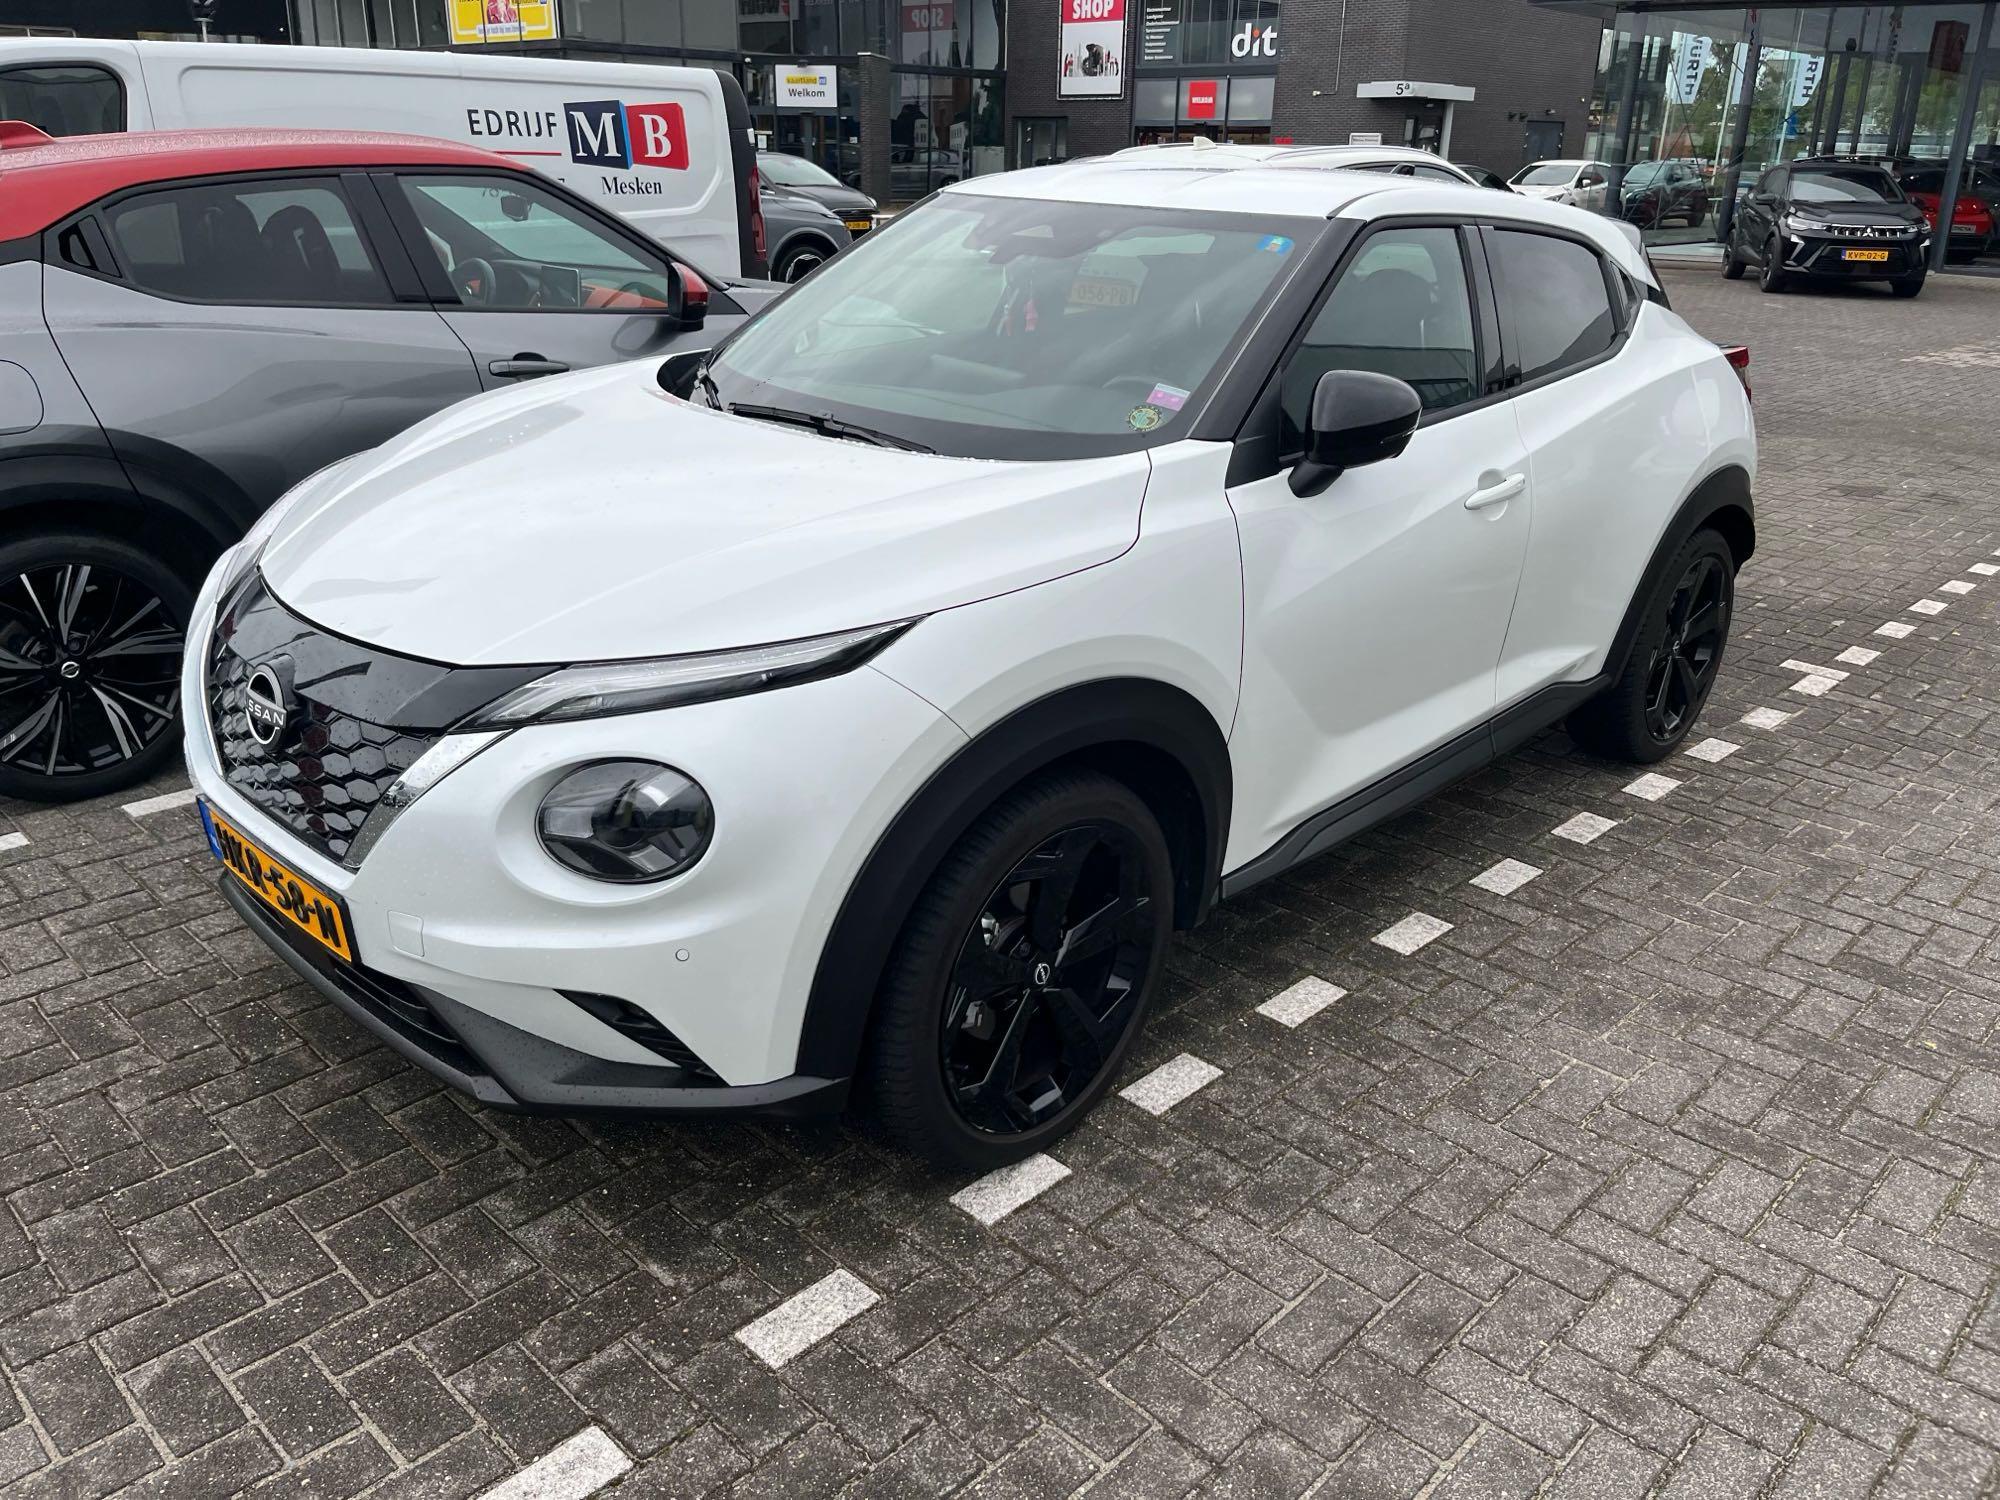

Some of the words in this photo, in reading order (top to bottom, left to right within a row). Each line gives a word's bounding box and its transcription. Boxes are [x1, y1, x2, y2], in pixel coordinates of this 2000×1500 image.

[1072, 0, 1114, 19] SHOP
[1231, 23, 1277, 58] dit
[1801, 56, 1819, 98] RTH
[788, 88, 826, 98] Welkom
[467, 109, 558, 138] EDRIJF
[602, 176, 663, 195] Mesken
[248, 698, 285, 726] SSAN
